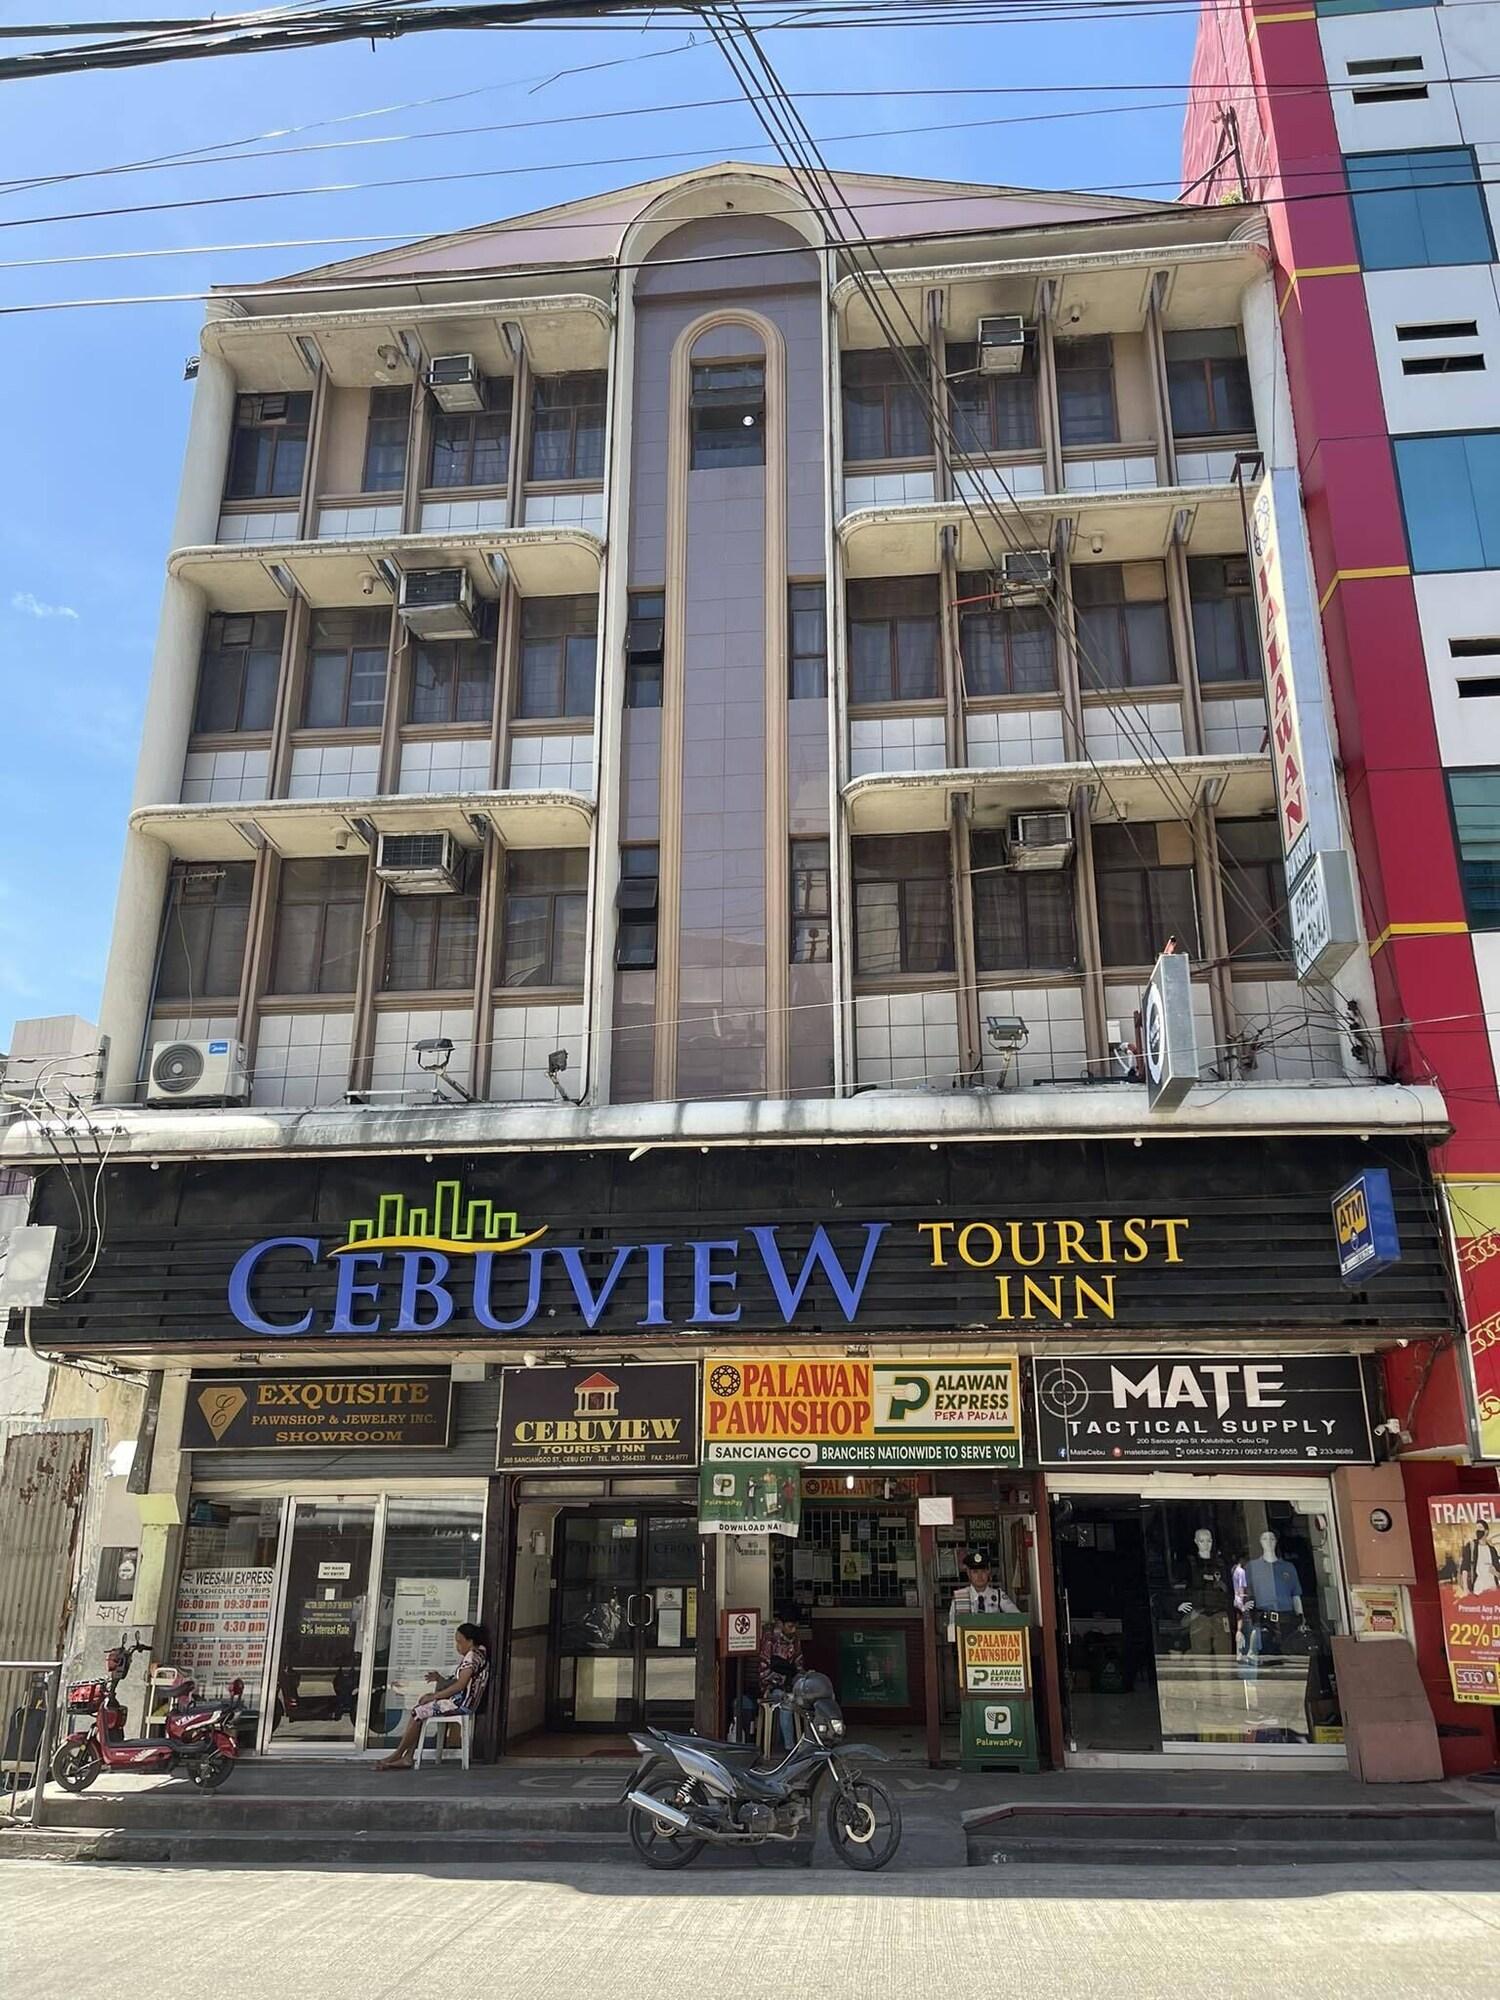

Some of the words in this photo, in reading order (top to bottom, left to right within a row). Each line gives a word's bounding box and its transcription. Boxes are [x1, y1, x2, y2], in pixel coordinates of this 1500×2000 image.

[1340, 1197, 1364, 1232] ATM
[918, 1218, 1189, 1267] TOURIST
[228, 1222, 892, 1335] CEBUVIEW
[995, 1275, 1117, 1320] INN
[742, 1364, 870, 1397] PALAWAN
[257, 1383, 430, 1410] EXQUISITE
[1110, 1364, 1287, 1420] MATE
[935, 1394, 1009, 1410] EXPRESS
[252, 1415, 325, 1425] PAWNSHOP
[328, 1414, 339, 1425] &
[342, 1414, 406, 1425] JEWELRY
[410, 1414, 437, 1424] INC.
[709, 1400, 871, 1435] PAWNSHOP
[934, 1411, 965, 1421] PERA
[967, 1411, 1008, 1421] PADALA
[514, 1419, 681, 1442] CEBUVIEW
[1068, 1420, 1208, 1436] TACTICAL
[1222, 1419, 1336, 1435] SUPPLY
[276, 1431, 403, 1442] SHOWROOM
[1255, 1437, 1269, 1445] City
[541, 1444, 612, 1454] TOURIST
[616, 1444, 645, 1453] INN
[715, 1446, 811, 1459] SANCIANGCO
[822, 1446, 875, 1460] BRANCHES
[878, 1446, 941, 1459] NATIONWIDE
[943, 1446, 958, 1459] TO
[960, 1446, 992, 1459] SERVE
[994, 1445, 1016, 1458] YOU
[821, 1479, 873, 1495] PALAAN
[719, 1523, 765, 1532] DOWNLOAD
[196, 1571, 233, 1585] WEESAM
[235, 1570, 273, 1584] EXPRESS
[205, 1600, 219, 1609] am
[224, 1599, 251, 1609] 09:30
[252, 1600, 268, 1608] am
[199, 1622, 215, 1633] pm
[223, 1621, 246, 1632] 4:30
[248, 1622, 265, 1633] pm
[301, 1624, 314, 1634] 3%
[315, 1624, 336, 1634] Interest
[336, 1624, 350, 1634] Rate
[1449, 1623, 1490, 1646] 22%
[977, 1634, 1020, 1647] PALAWAN
[968, 1648, 1020, 1662] PAWNSHOP
[976, 1738, 1023, 1748] PalawanPay
